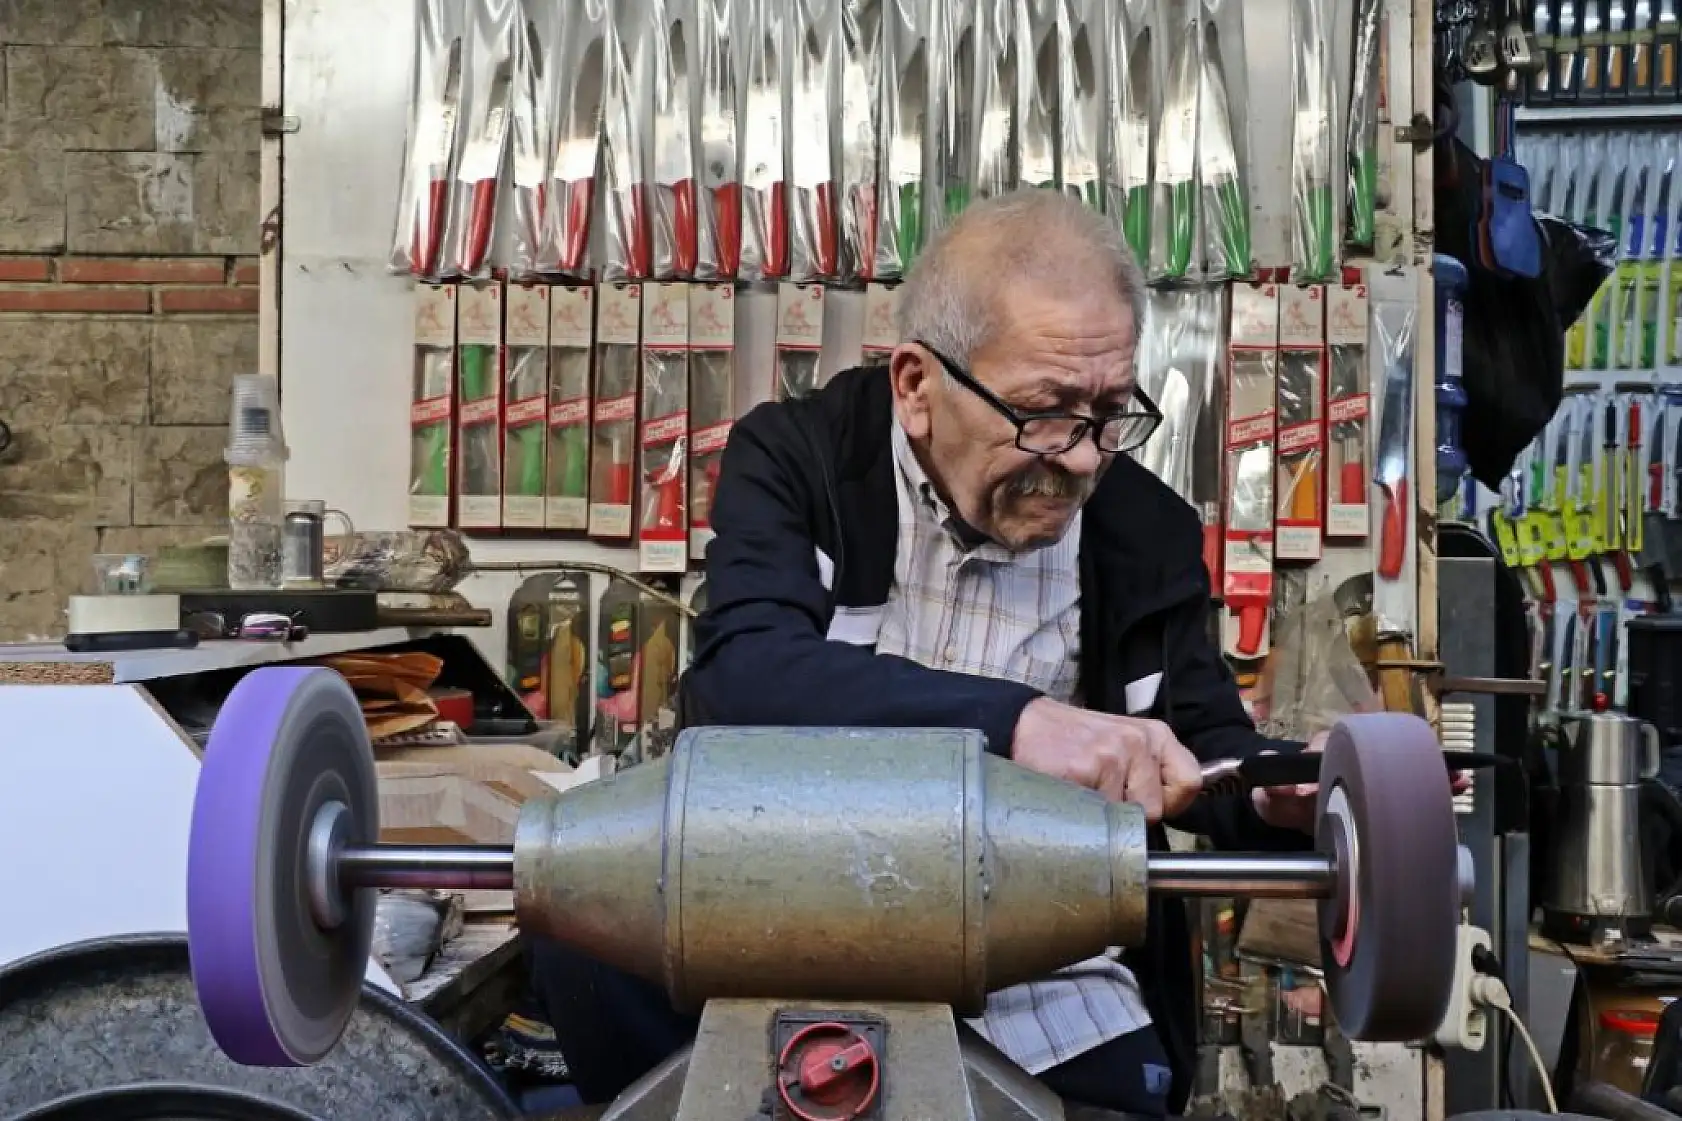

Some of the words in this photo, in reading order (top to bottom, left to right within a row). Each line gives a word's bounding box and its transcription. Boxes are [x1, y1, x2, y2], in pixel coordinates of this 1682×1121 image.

[628, 286, 639, 298] 2
[721, 287, 732, 299] 3
[1264, 286, 1276, 298] 4
[1309, 288, 1320, 300] 3
[1357, 286, 1366, 299] 2
